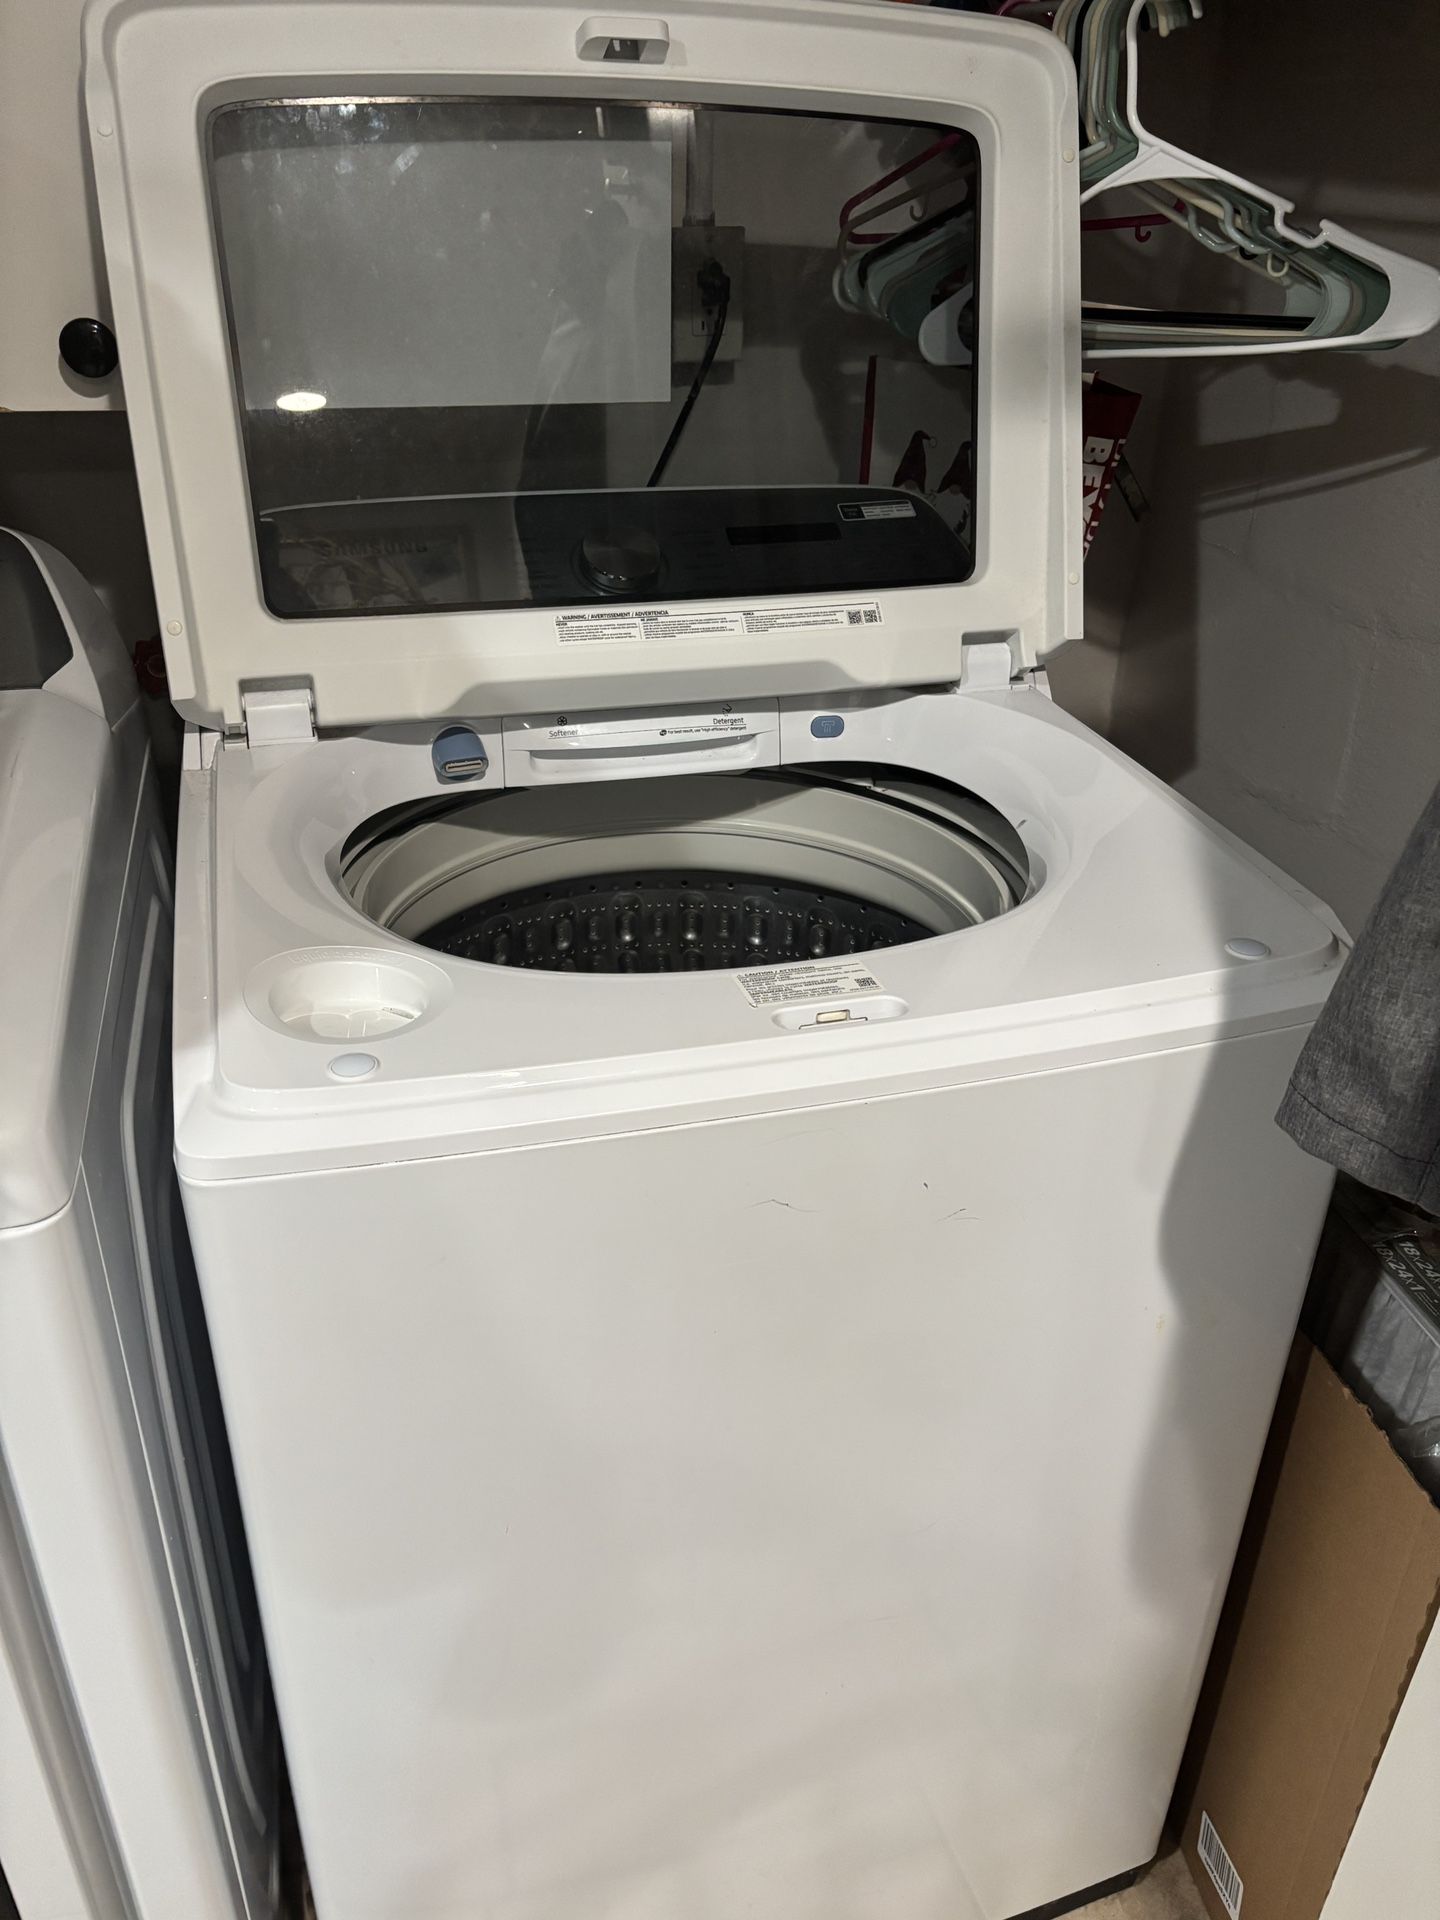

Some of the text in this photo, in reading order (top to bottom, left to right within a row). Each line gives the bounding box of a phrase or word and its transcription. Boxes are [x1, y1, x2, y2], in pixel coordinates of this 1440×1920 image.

[590, 611, 631, 619] AVERTISSEMENT
[634, 609, 669, 617] ADVERTENCIA
[713, 716, 744, 726] Detergent
[549, 728, 578, 738] Softener
[777, 965, 815, 973] ATTENTION
